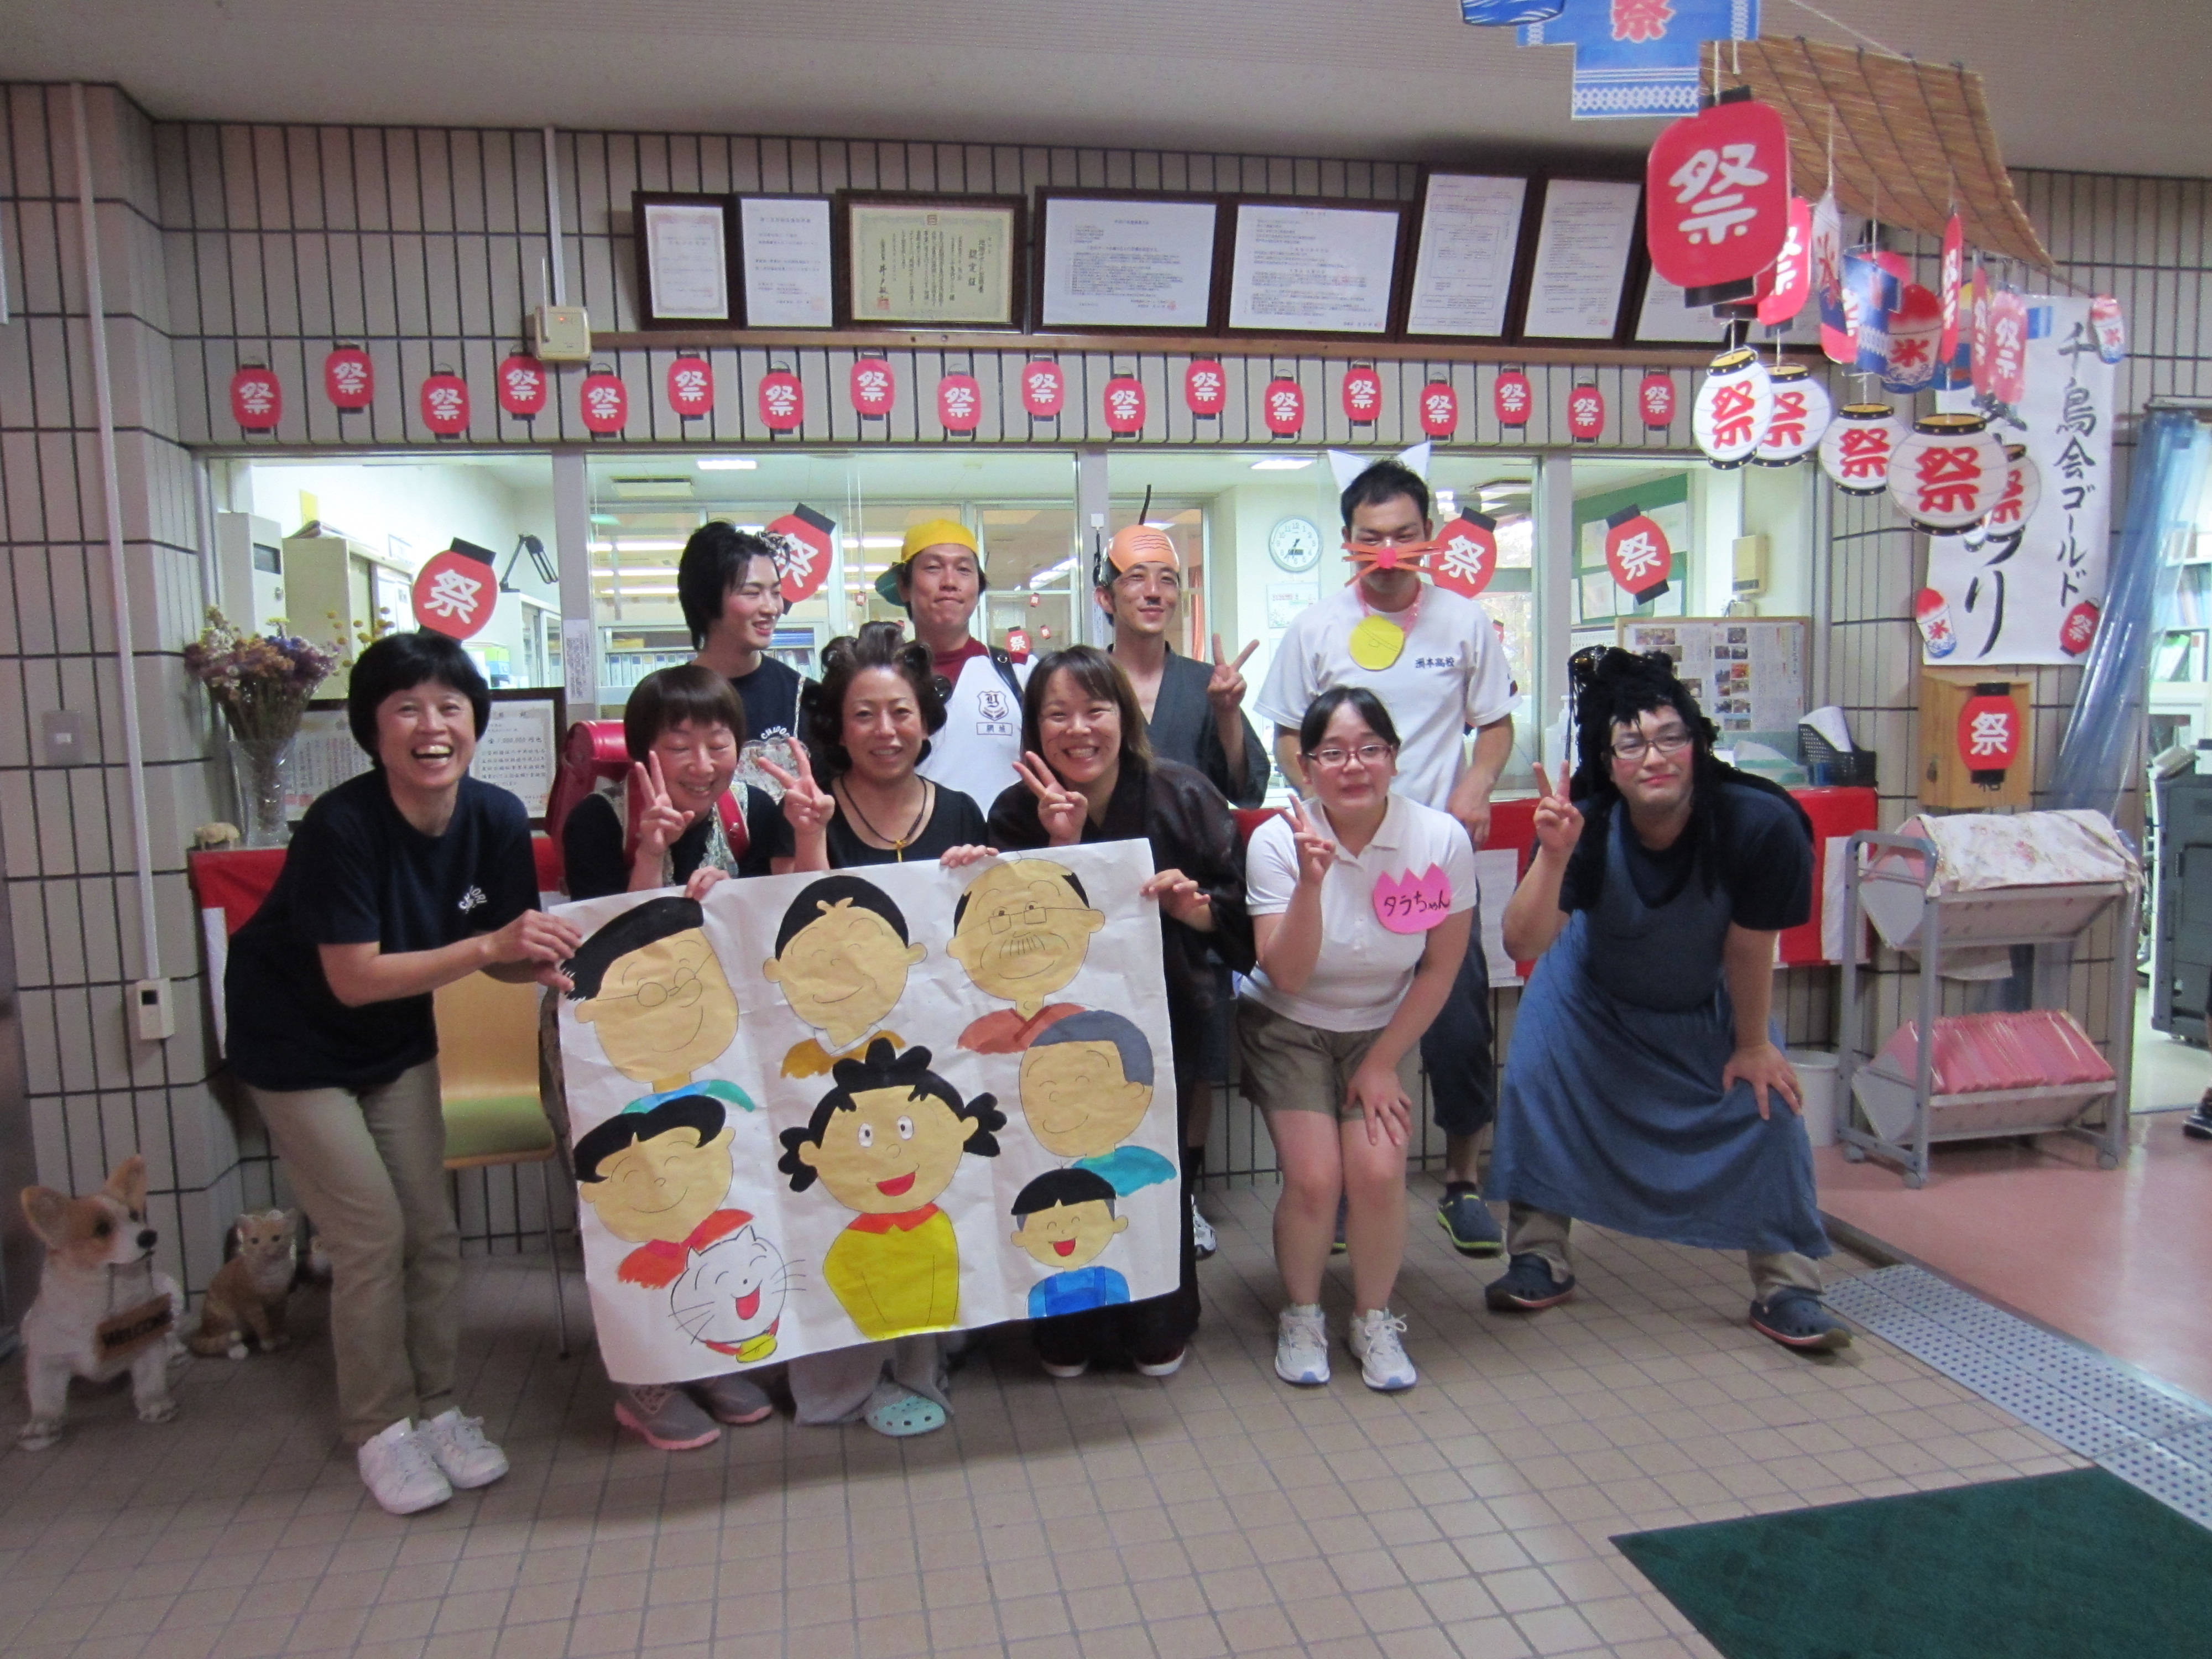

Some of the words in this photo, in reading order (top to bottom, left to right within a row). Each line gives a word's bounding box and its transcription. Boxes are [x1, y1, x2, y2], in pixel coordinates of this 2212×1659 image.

[1670, 144, 1768, 244] 祭
[1891, 338, 1929, 368] 氷
[1995, 317, 2021, 378] 祭
[333, 362, 367, 394] 祭
[507, 369, 540, 401] 祭
[675, 371, 707, 401] 祭
[858, 371, 888, 401] 祭
[1029, 373, 1058, 403] 祭
[1192, 372, 1220, 401] 祭
[239, 382, 274, 414] 祭
[429, 389, 463, 420] 祭
[588, 388, 620, 419] 祭
[765, 385, 797, 416] 祭
[945, 388, 975, 418] 祭
[1110, 390, 1139, 420] 祭
[1271, 392, 1298, 421] 祭
[1350, 380, 1380, 408] 祭
[1426, 395, 1453, 423] 祭
[1500, 384, 1526, 411] 祭
[1645, 387, 1671, 414] 祭
[1573, 398, 1599, 426] 祭
[1712, 380, 1755, 449] 祭
[1764, 392, 1807, 447] 祭
[1840, 428, 1890, 478] 祭
[2053, 322, 2097, 607] 千鳥会ゴールド
[1916, 446, 1981, 513] 祭
[1439, 534, 1485, 585] 祭
[1616, 532, 1661, 580] 祭
[424, 569, 482, 624] 祭
[1928, 619, 1949, 640] 氷
[2070, 613, 2094, 642] 祭
[1010, 635, 1026, 651] 祭
[1971, 712, 2009, 756] 祭
[1384, 889, 1451, 917] タラちゃん
